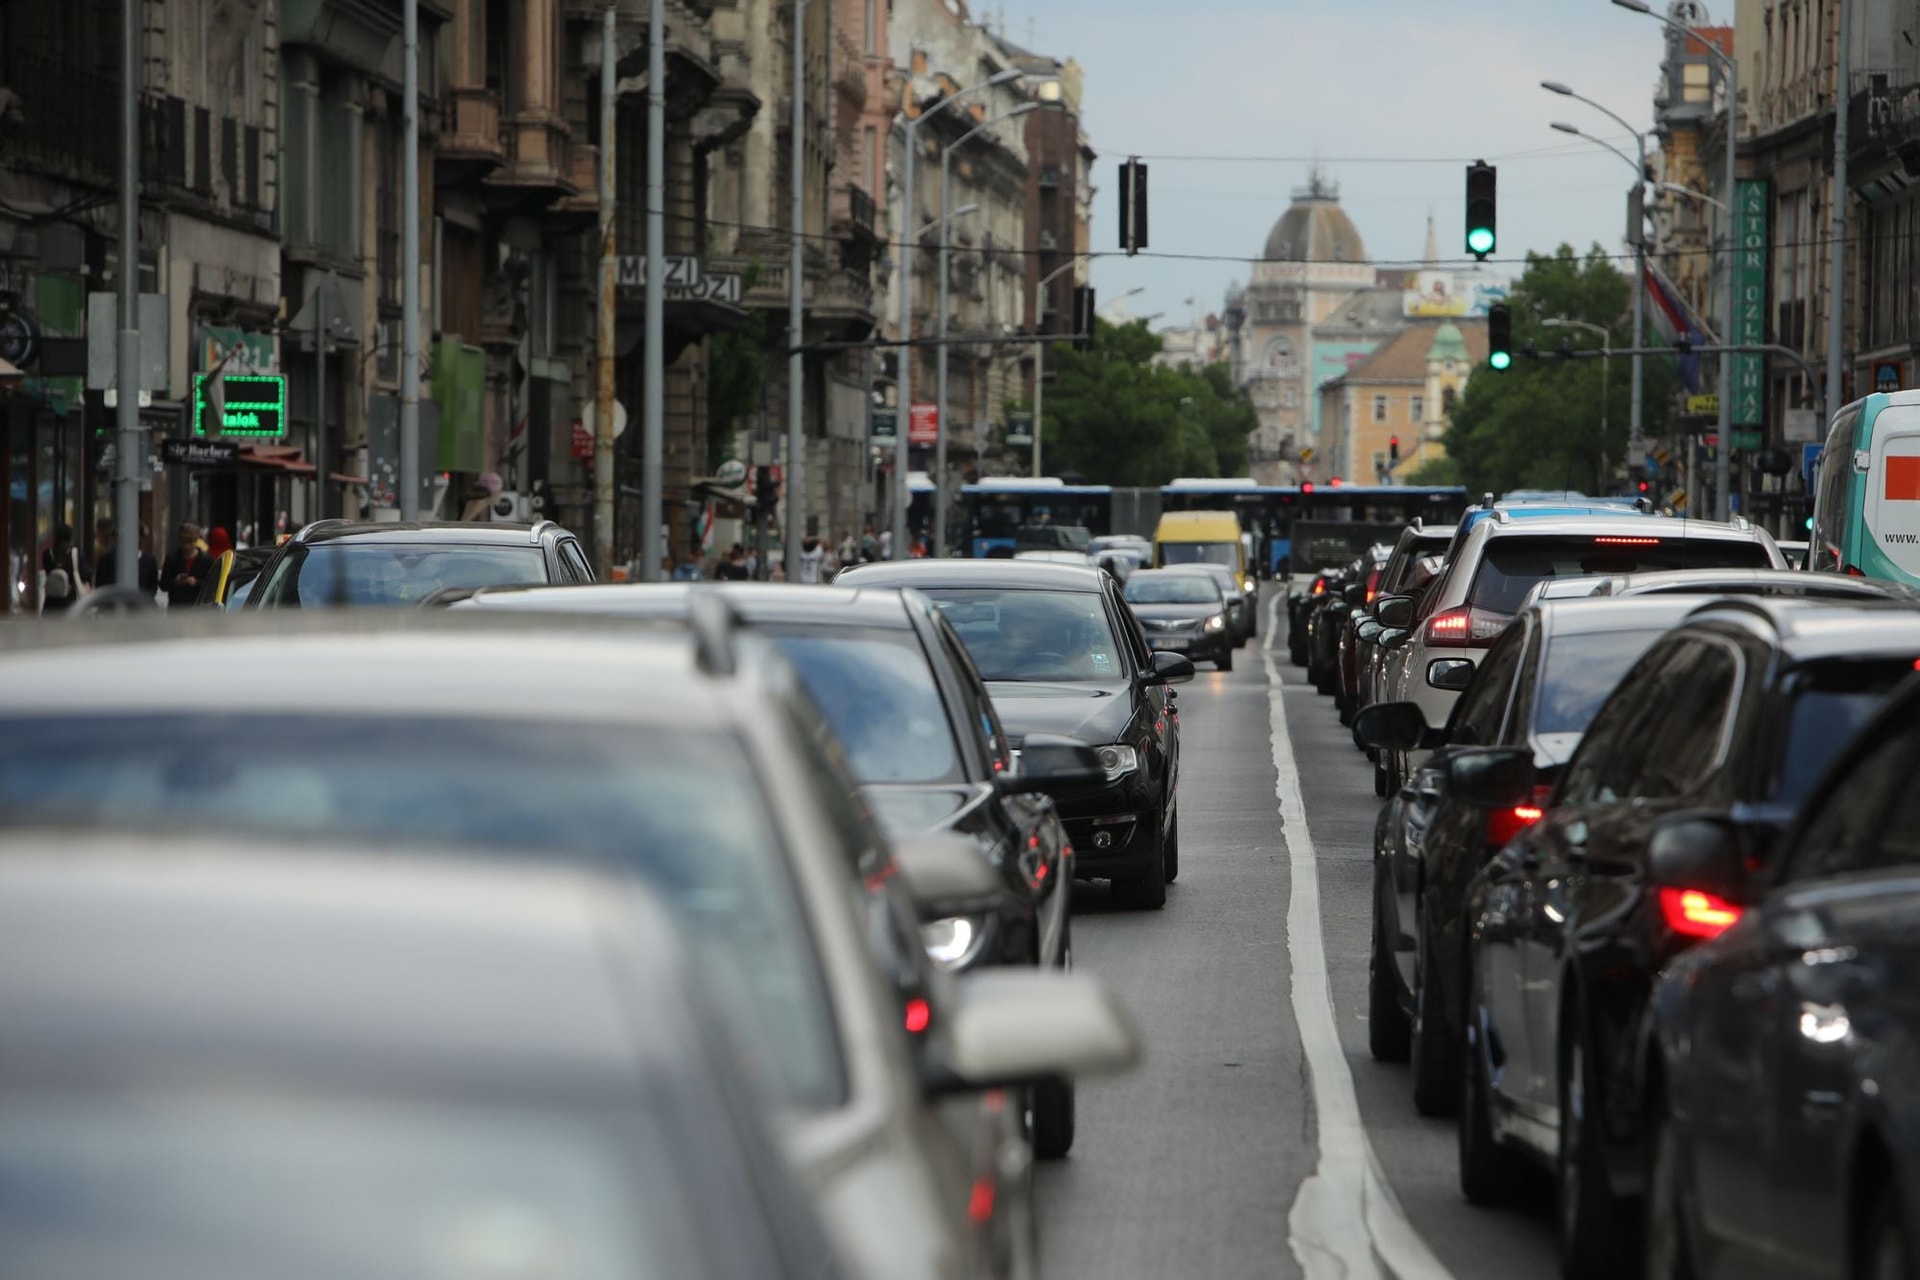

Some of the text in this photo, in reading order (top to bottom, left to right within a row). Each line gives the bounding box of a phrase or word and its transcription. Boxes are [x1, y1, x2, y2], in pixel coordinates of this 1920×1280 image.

[1745, 182, 1761, 268] ASTOR
[617, 257, 692, 283] MZI
[1885, 534, 1919, 544] www.
